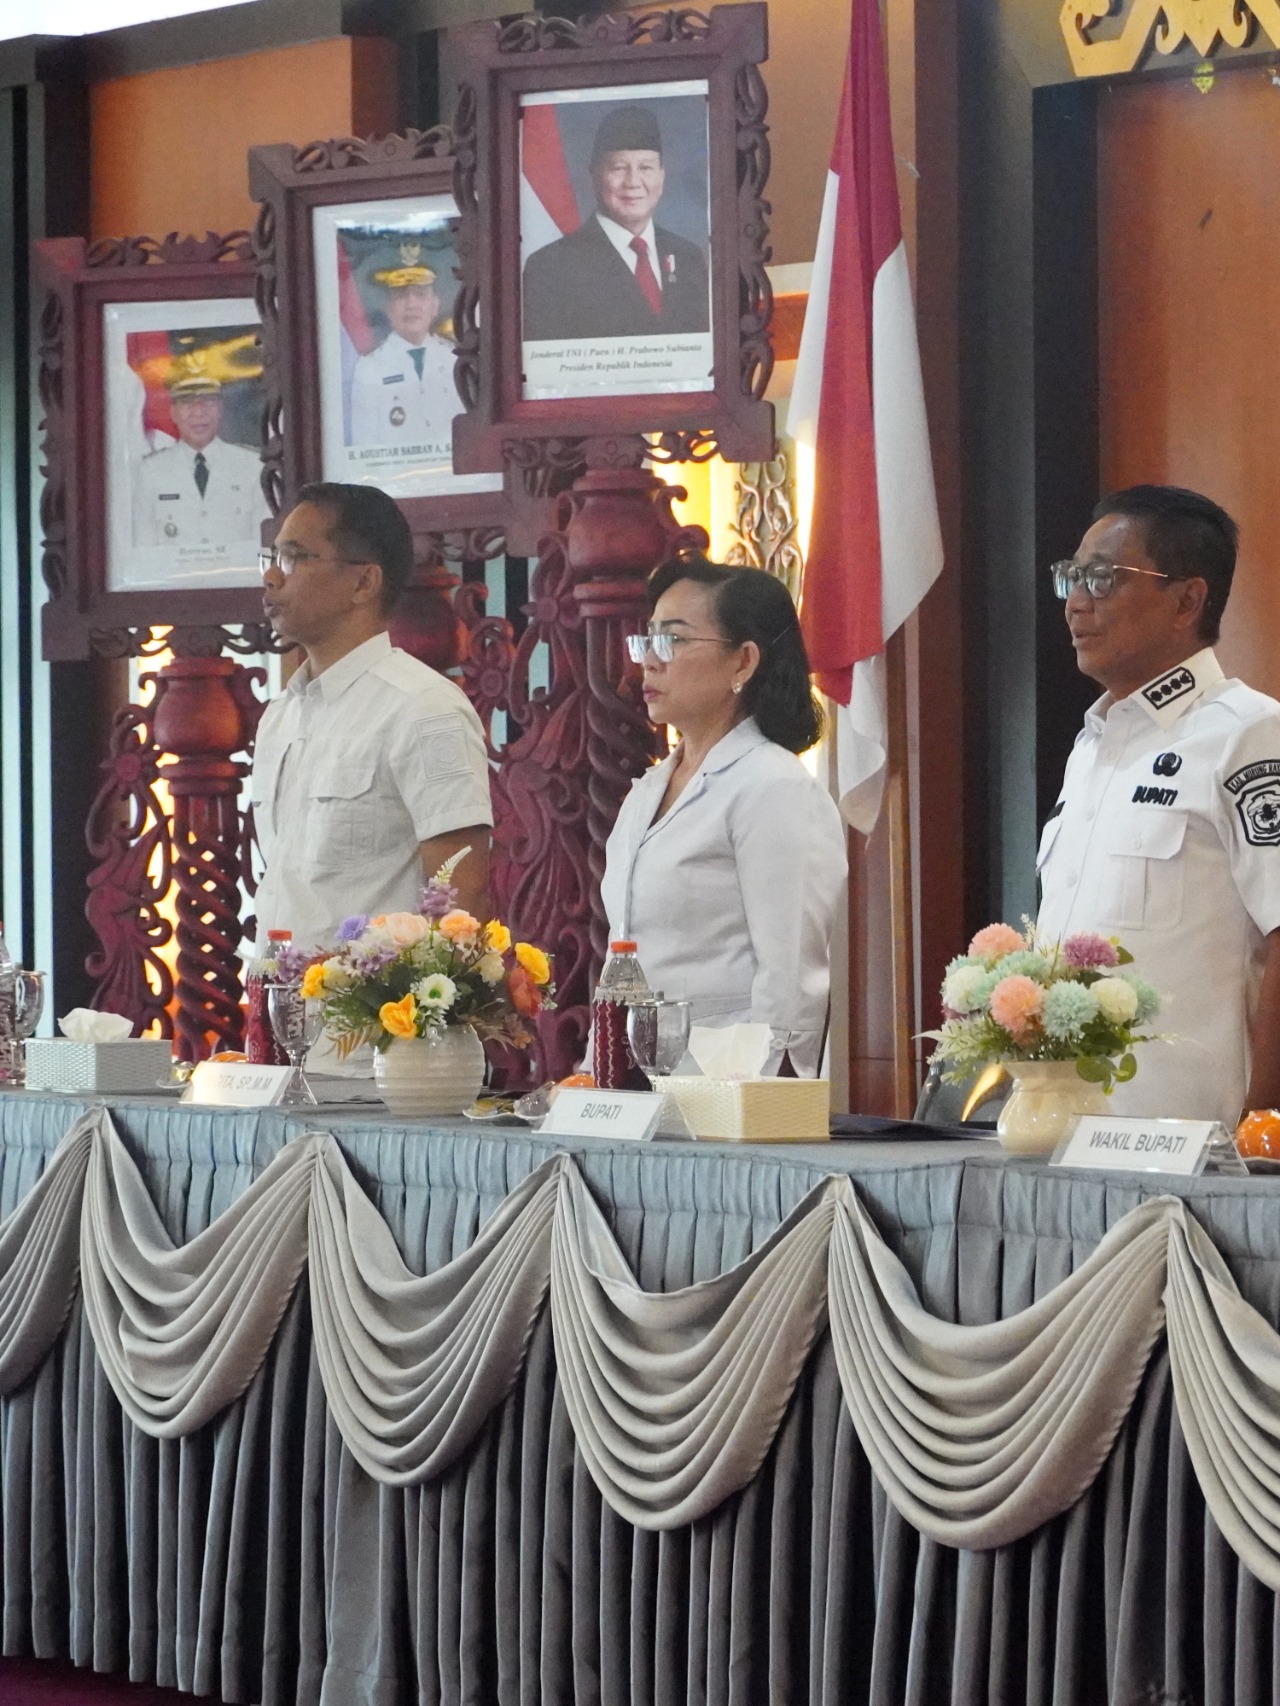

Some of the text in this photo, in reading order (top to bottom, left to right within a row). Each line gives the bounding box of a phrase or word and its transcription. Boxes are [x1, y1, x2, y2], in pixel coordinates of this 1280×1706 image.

[559, 360, 673, 373] Presiden Republik Indonesia
[1132, 785, 1178, 806] BUPATI
[580, 1102, 623, 1120] BUPATI
[1089, 1131, 1188, 1154] WAKIL BUPATI
